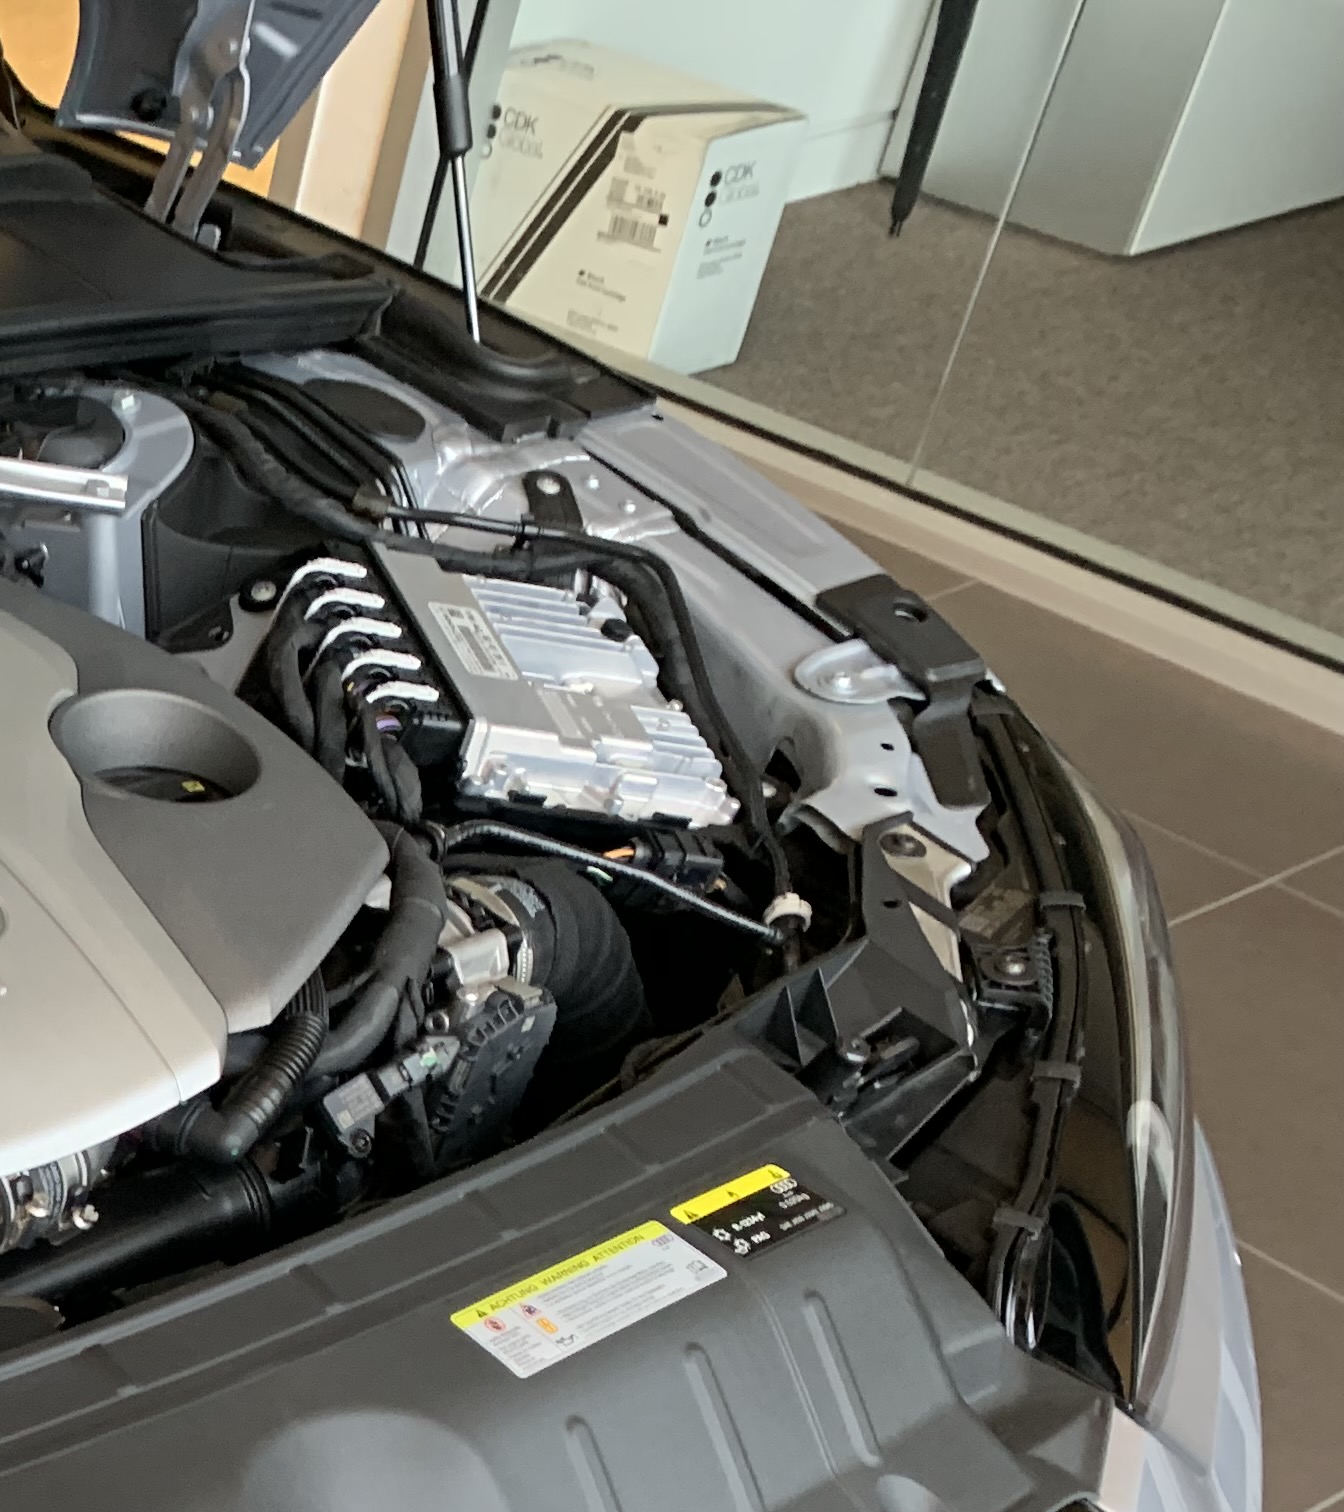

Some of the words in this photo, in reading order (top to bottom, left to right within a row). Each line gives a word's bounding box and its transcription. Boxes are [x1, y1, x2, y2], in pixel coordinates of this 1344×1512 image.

[504, 107, 538, 136] CDK
[724, 160, 757, 185] CDK
[489, 1284, 539, 1312] ACHTUNG
[541, 1259, 591, 1287] WARNING
[592, 1233, 646, 1263] ATTENTION
